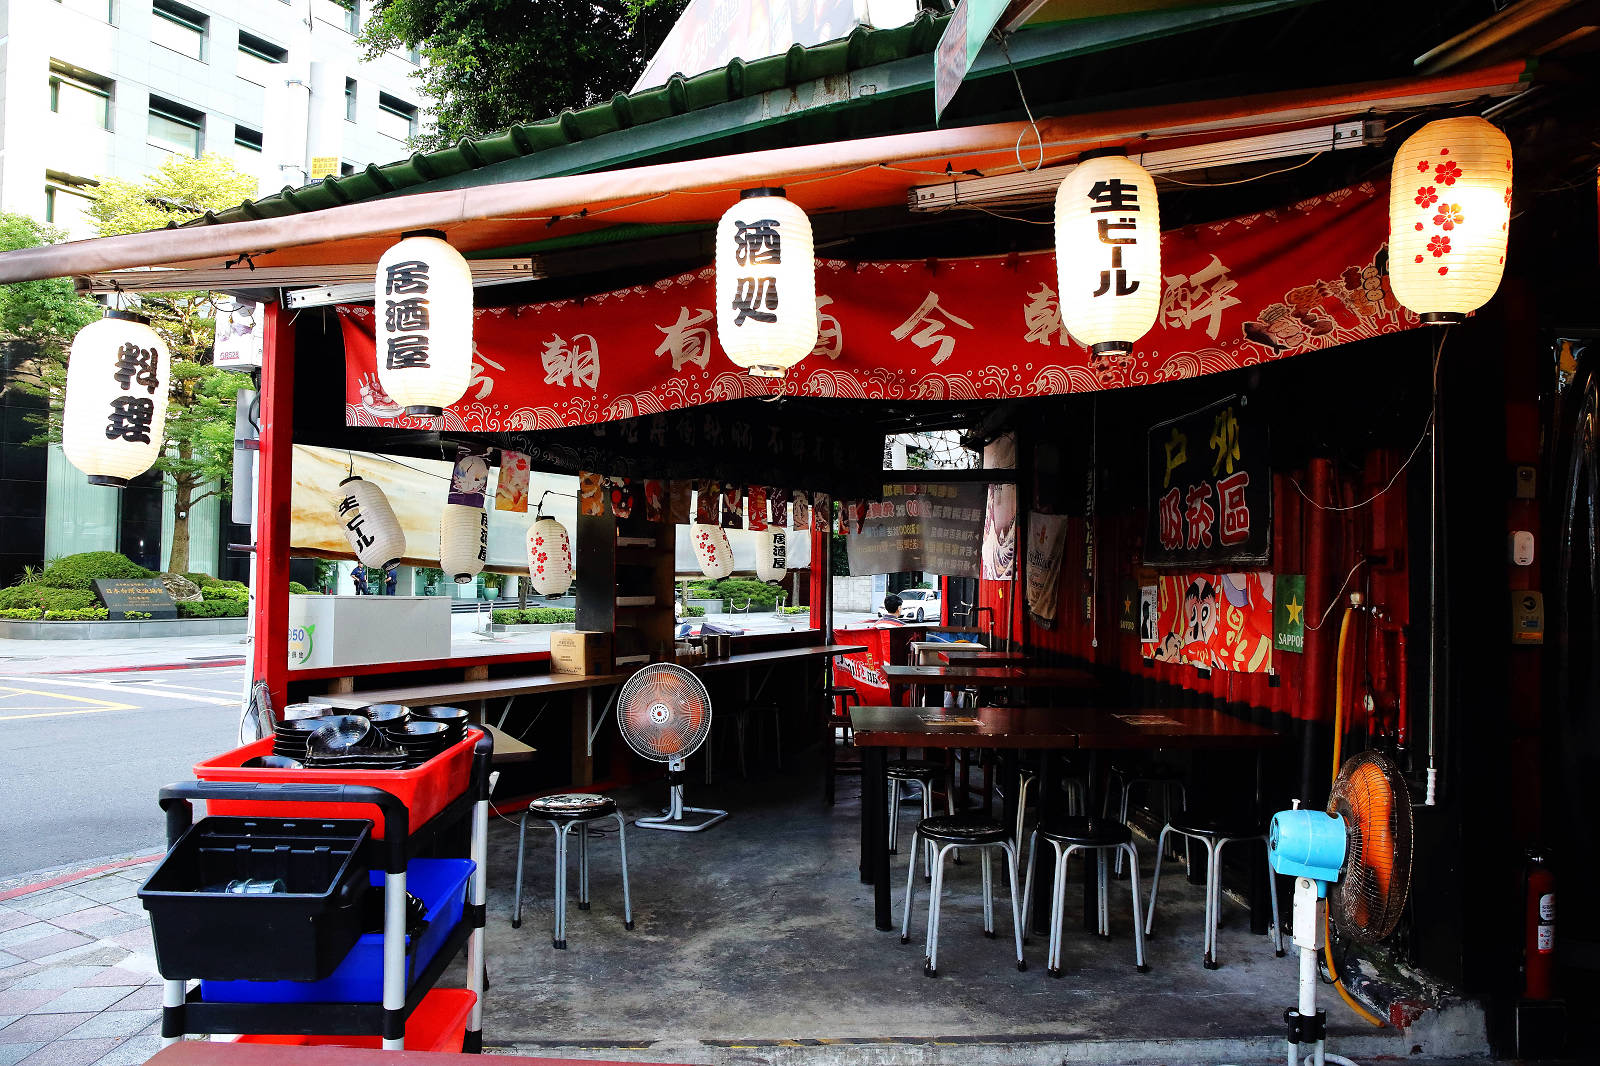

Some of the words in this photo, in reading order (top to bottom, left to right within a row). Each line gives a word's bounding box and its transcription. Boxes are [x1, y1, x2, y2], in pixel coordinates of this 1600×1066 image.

[1088, 179, 1140, 298] 生ビール
[386, 261, 430, 370] 居酒屋
[106, 342, 159, 445] 料理
[772, 533, 786, 569] 居酒屋
[1159, 470, 1250, 550] 吸菸區
